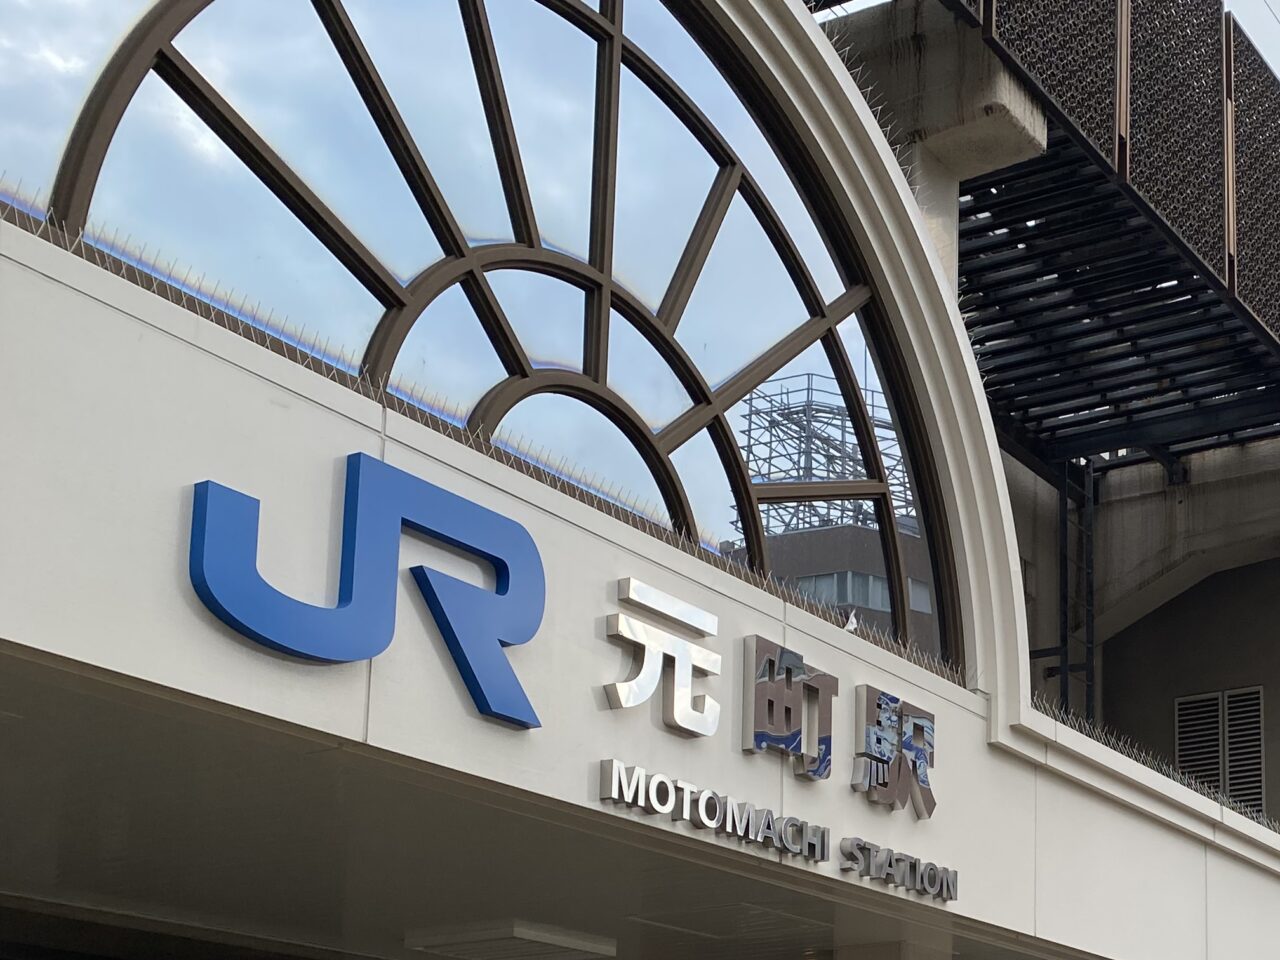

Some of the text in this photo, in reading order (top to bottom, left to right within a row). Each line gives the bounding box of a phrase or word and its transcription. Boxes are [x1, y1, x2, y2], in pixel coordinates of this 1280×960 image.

[190, 452, 937, 818] JR 元町駅
[600, 758, 958, 901] MOTOMACHI STATION
